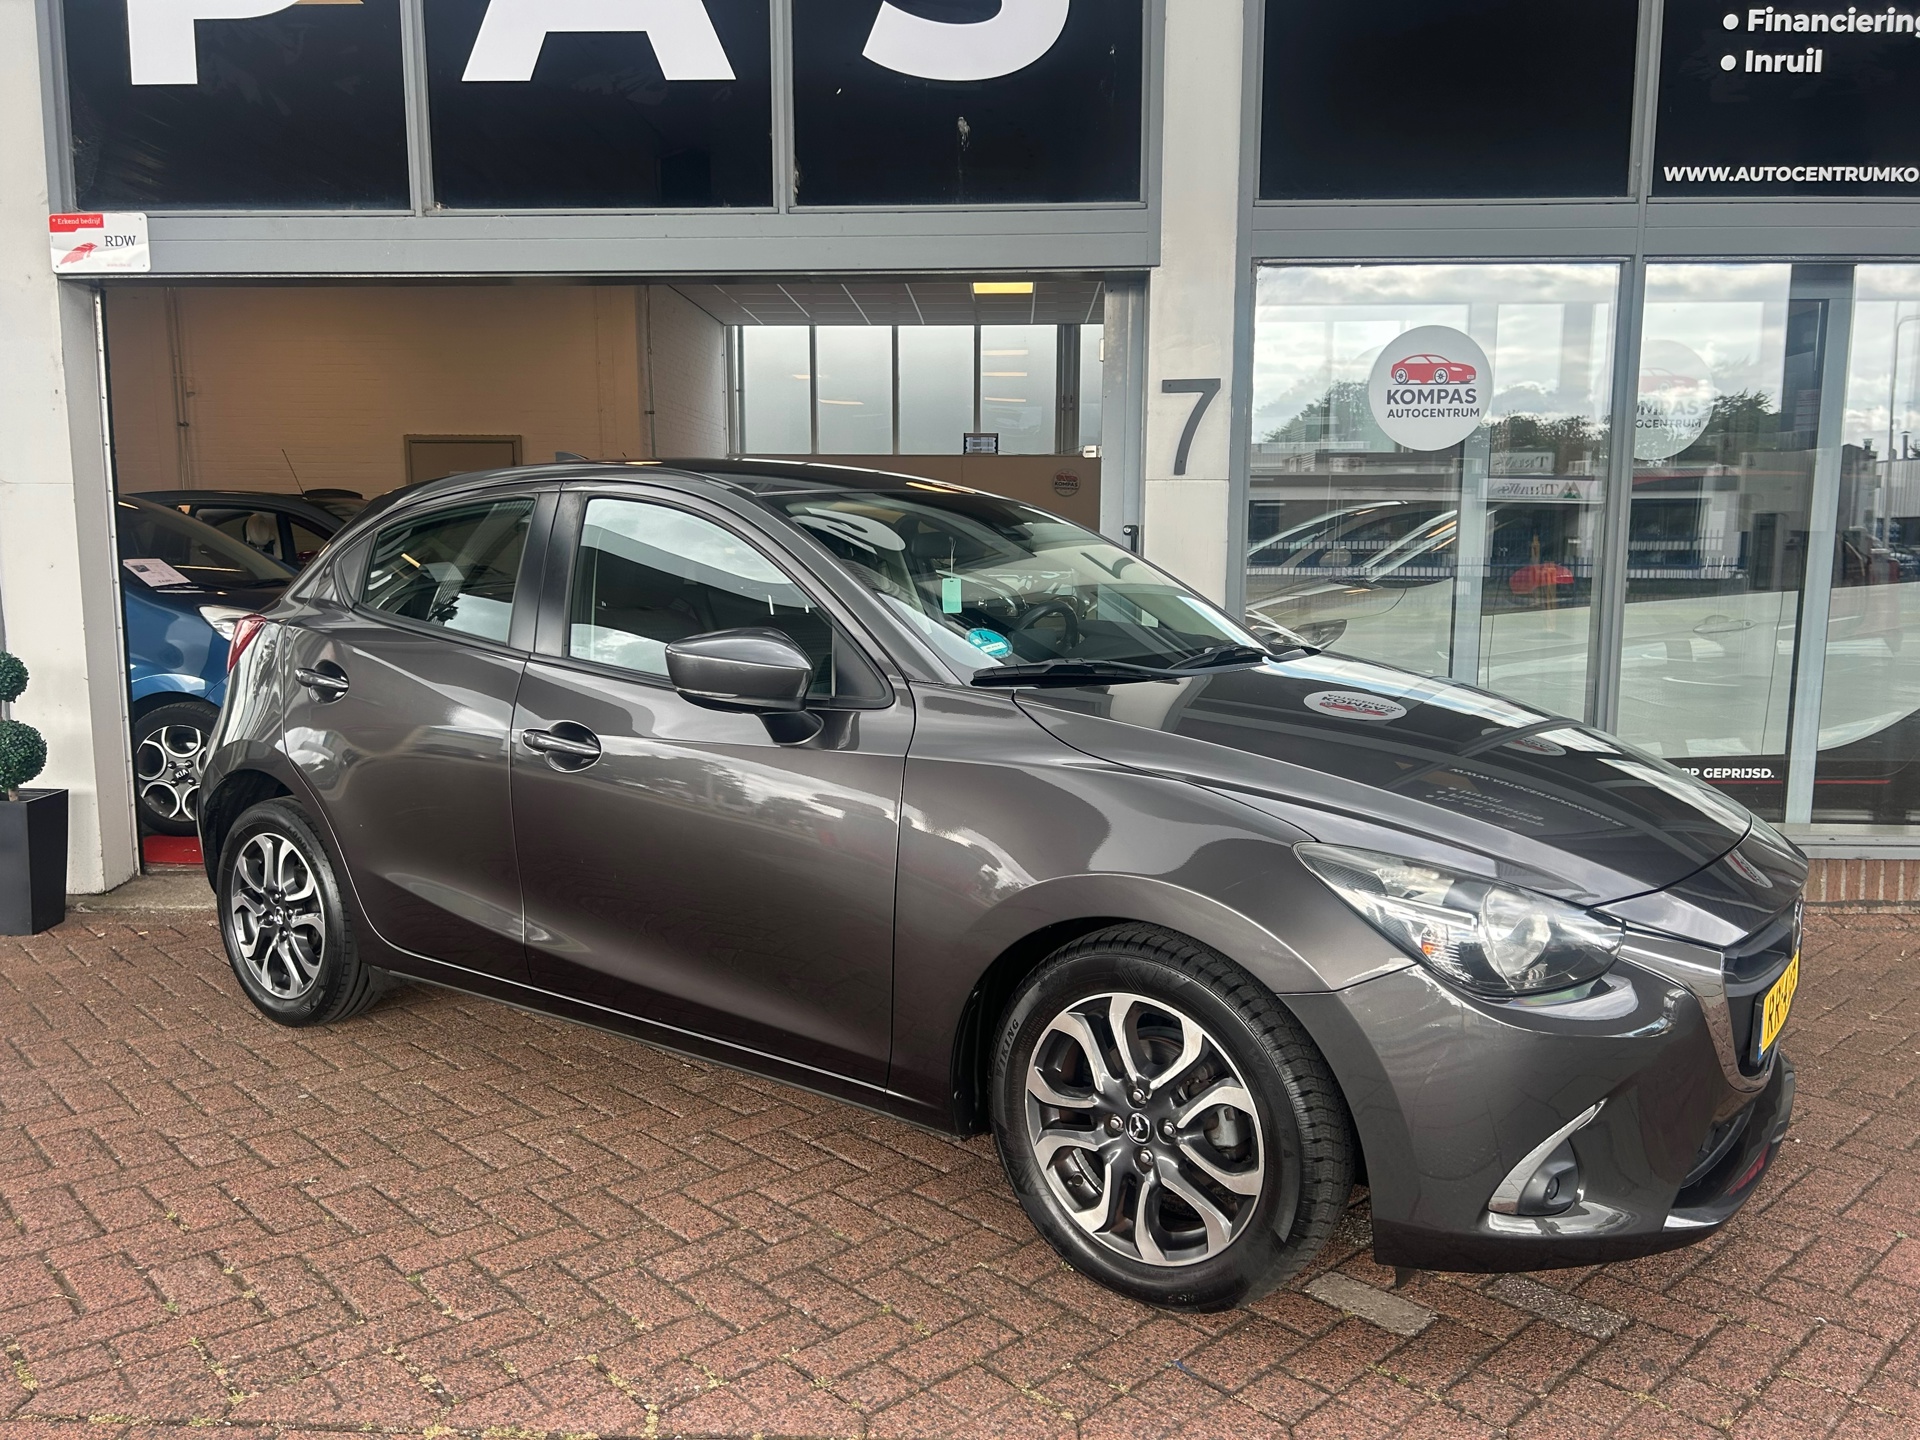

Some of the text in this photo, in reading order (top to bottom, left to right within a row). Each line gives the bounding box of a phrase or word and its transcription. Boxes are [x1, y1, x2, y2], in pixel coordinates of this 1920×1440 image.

[1745, 47, 1823, 73] Inruil
[1663, 166, 1920, 182] WWW.AUTOCENTRUMKO
[81, 217, 101, 226] bedrijf
[104, 235, 136, 247] RDW
[1386, 388, 1477, 405] KOMPAS
[1387, 408, 1480, 418] AUTOCENTRUM
[1162, 378, 1221, 475] 7
[175, 768, 188, 779] KIA
[1703, 767, 1775, 779] GEPRIJSD.
[996, 1019, 1020, 1079] VIKING
